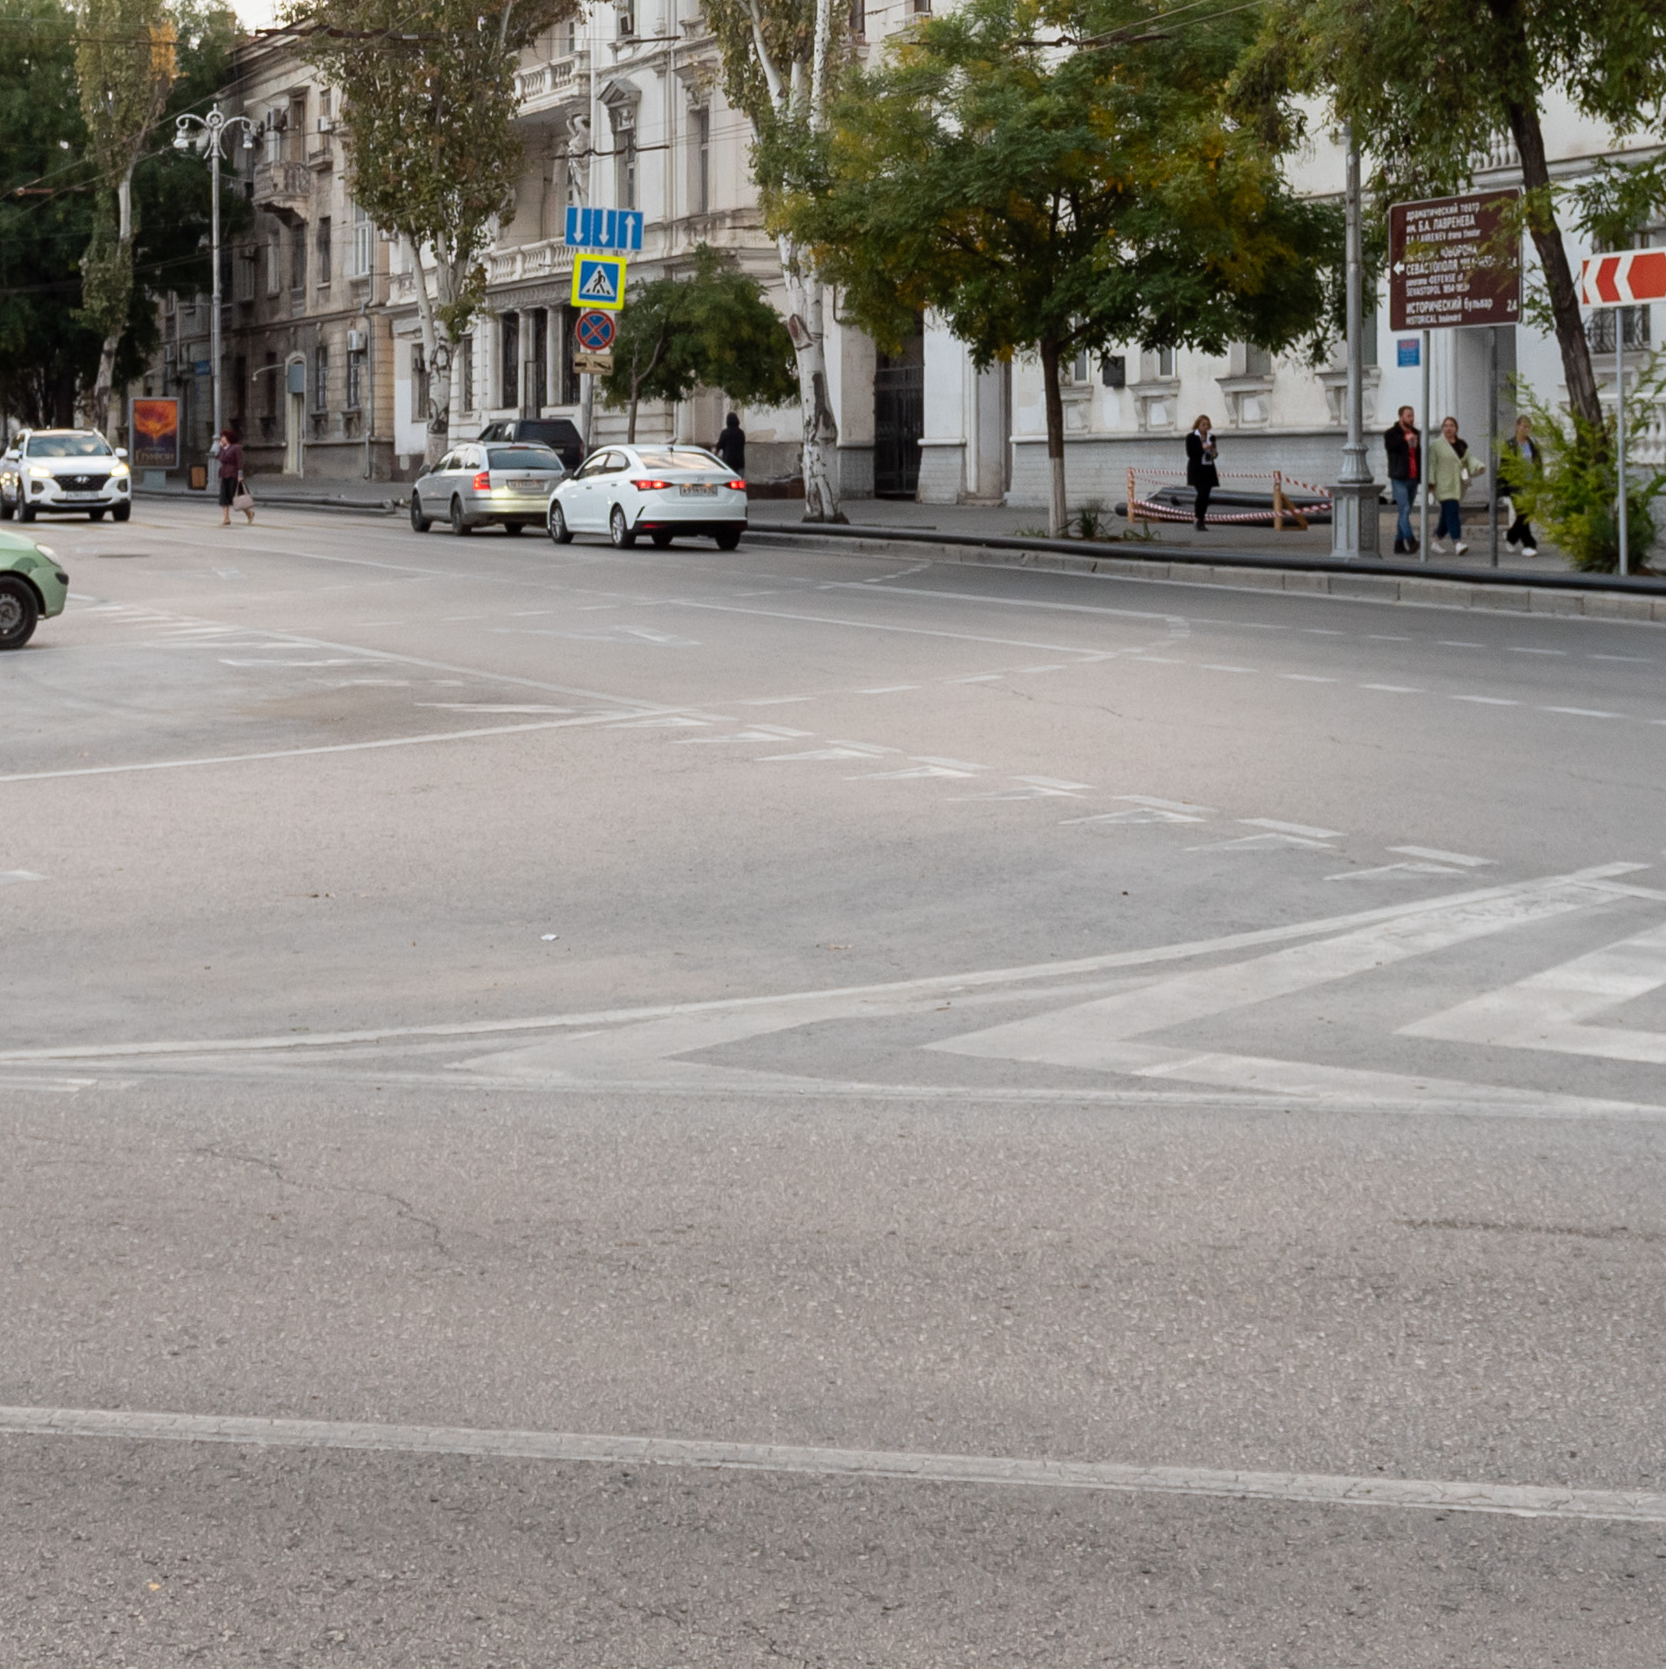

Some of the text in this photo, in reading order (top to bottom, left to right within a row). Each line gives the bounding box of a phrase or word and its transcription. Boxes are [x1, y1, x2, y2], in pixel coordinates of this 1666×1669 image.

[1406, 202, 1480, 222] драматический театр
[1433, 214, 1476, 230] ЛАВРЕНЕВА
[1406, 259, 1458, 276] СЕВАСТОПОЛЯ
[1406, 295, 1462, 314] ИСТОРИЧЕСКИЙ
[1464, 297, 1493, 312] бульвар
[1406, 314, 1437, 325] HISTORICAL
